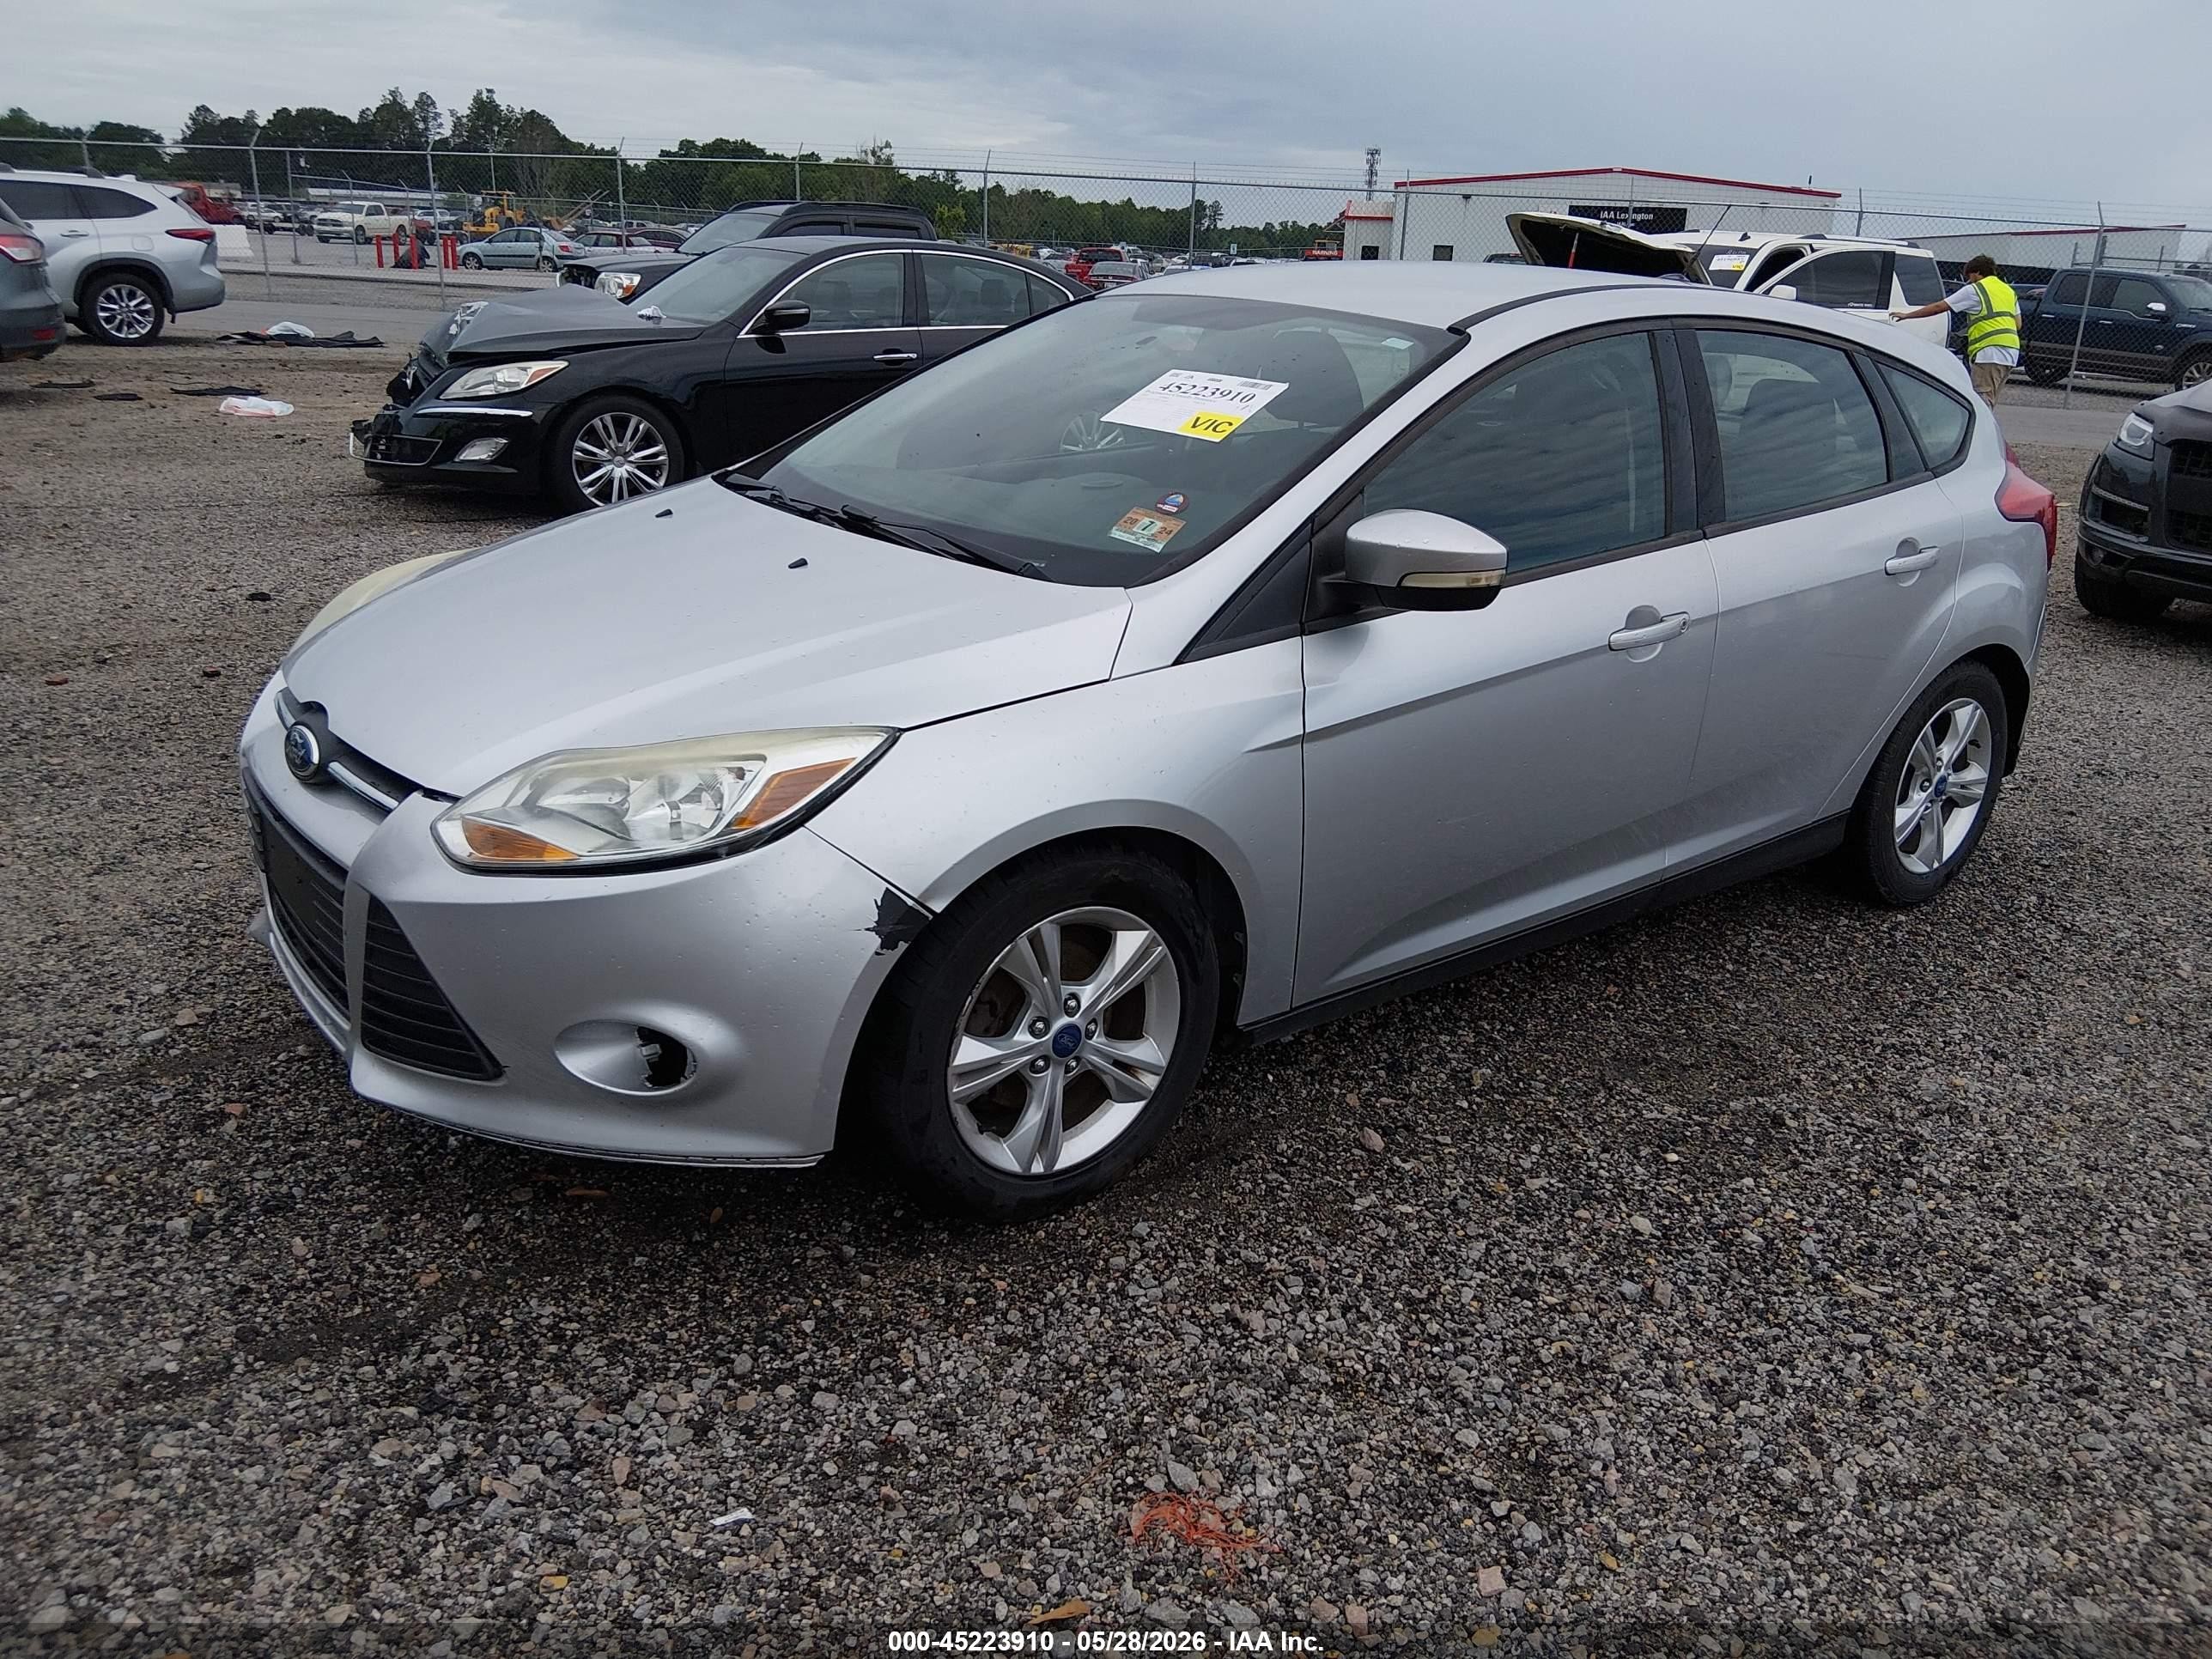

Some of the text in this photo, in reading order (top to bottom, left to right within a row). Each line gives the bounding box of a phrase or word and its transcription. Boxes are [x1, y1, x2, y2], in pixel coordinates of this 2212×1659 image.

[1600, 210, 1614, 219] IAA
[1158, 380, 1256, 404] 45223910
[1190, 416, 1234, 434] VIC
